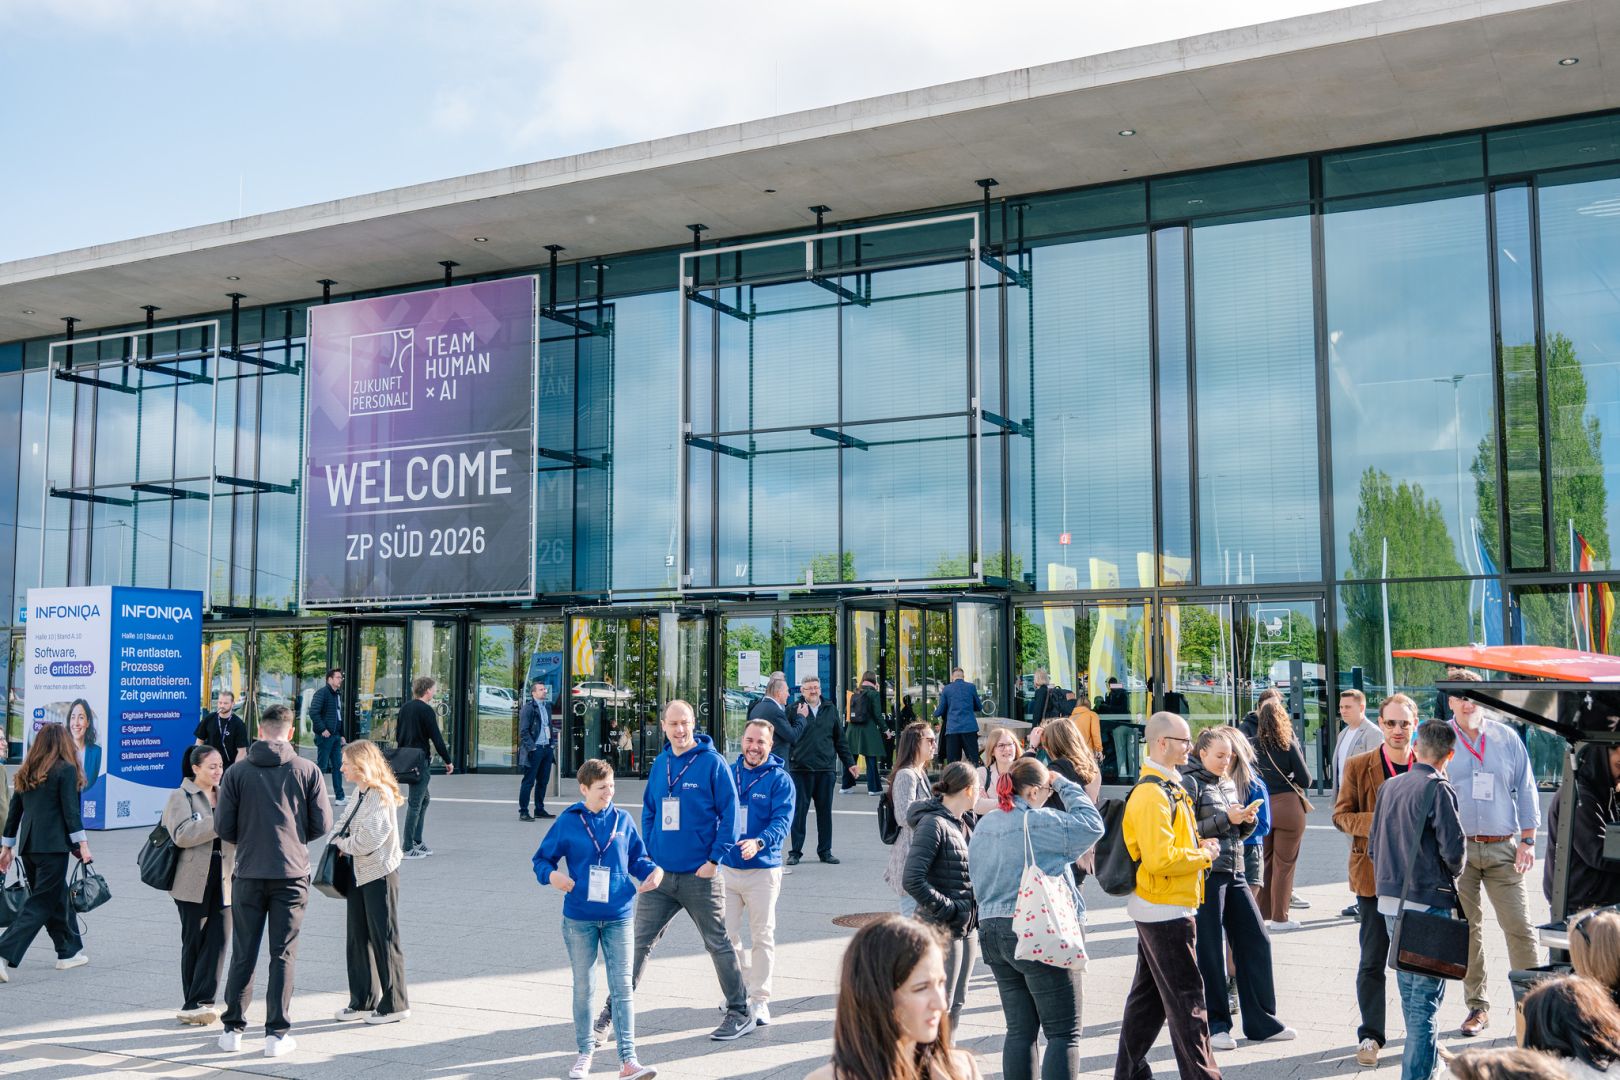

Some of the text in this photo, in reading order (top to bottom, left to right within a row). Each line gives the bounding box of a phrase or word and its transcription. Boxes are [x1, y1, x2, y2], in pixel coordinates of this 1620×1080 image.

[425, 331, 475, 357] TEAM
[425, 352, 490, 380] HUMAN
[353, 376, 402, 394] ZUKUNFT
[440, 379, 457, 401] AI
[325, 448, 513, 507] WELCOME
[346, 524, 486, 561] ZP SÜD 2026
[35, 604, 100, 621] INFONIQA
[121, 604, 193, 623] INFONIQA
[34, 646, 77, 660] Software,
[121, 646, 182, 659] HR entlasten.
[34, 663, 48, 675] die
[52, 663, 92, 675] entlastet
[121, 661, 164, 672] Prozesse
[120, 675, 192, 686] automatisieren.
[120, 689, 188, 703] Zeit gewinnen.
[122, 711, 180, 720] Digitale Personalakte
[121, 725, 151, 733] E-Signatur
[121, 751, 169, 760] Skillmanagement
